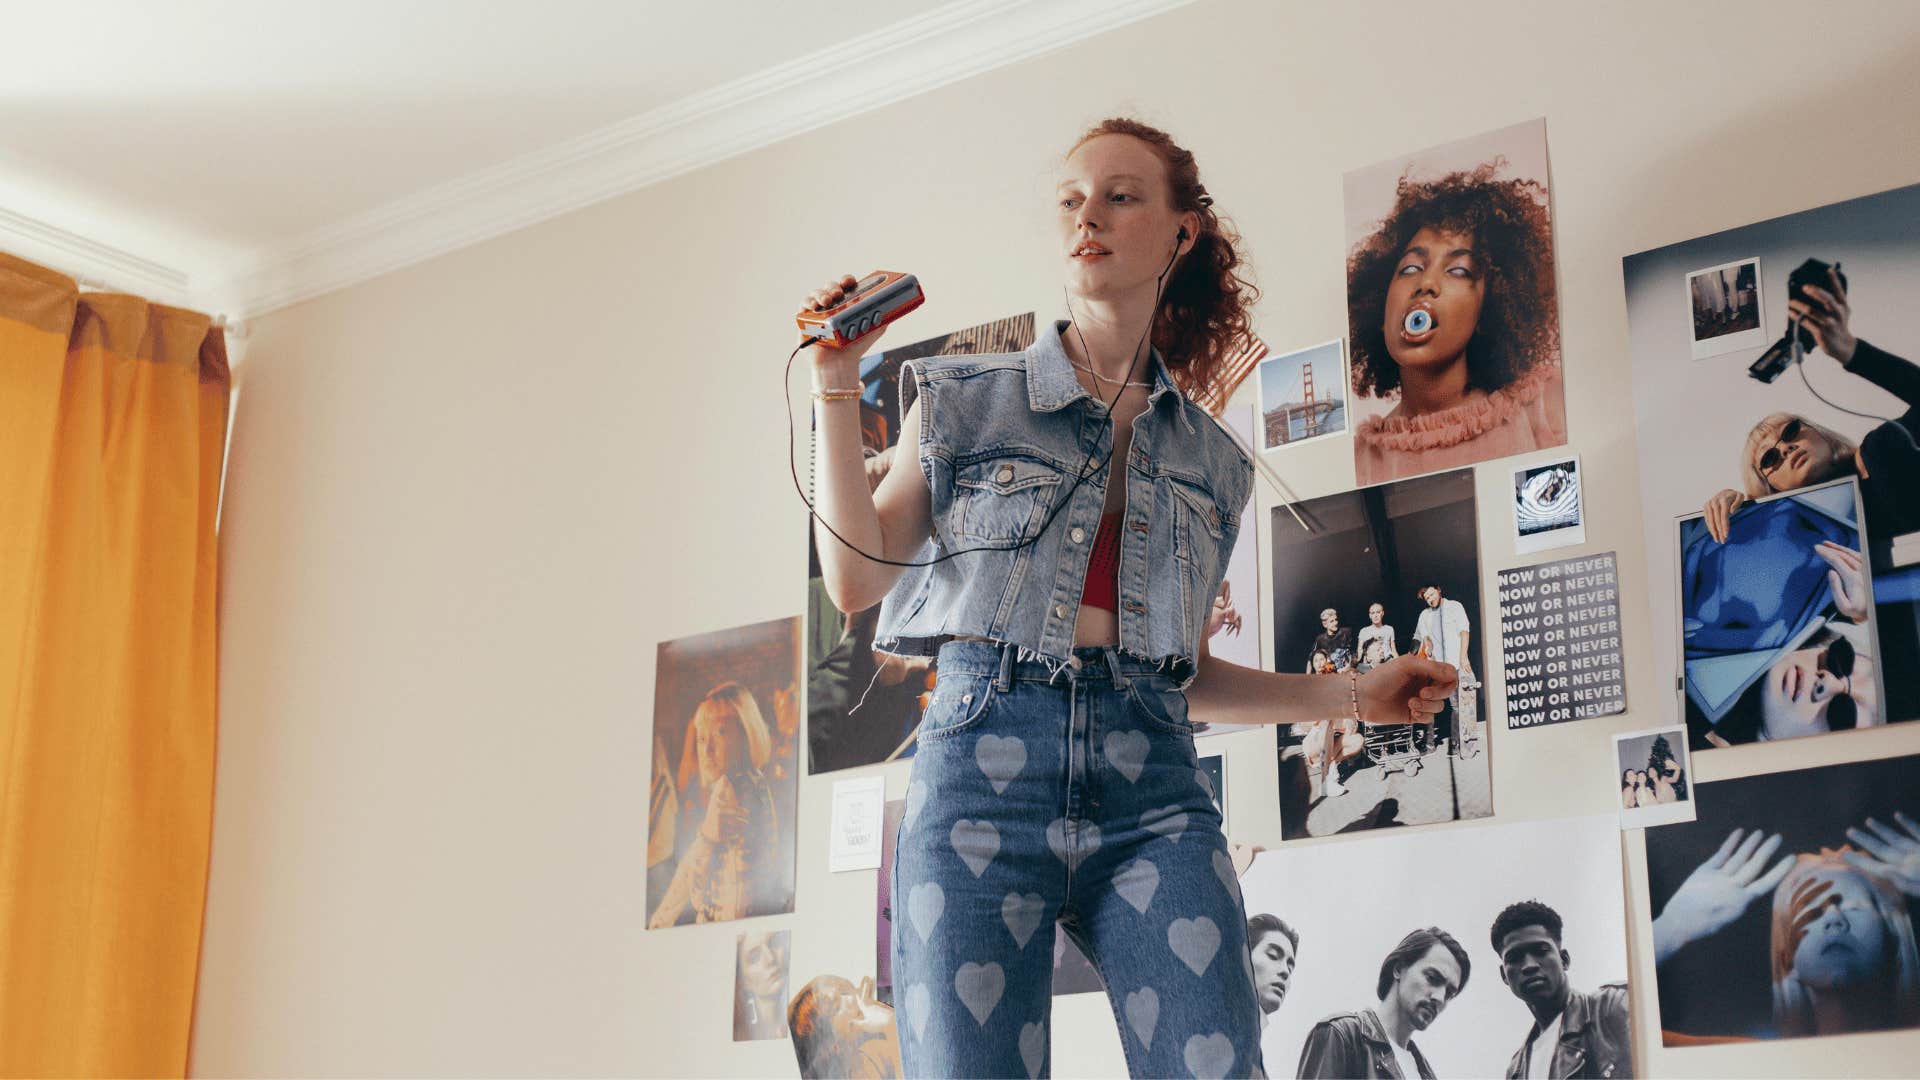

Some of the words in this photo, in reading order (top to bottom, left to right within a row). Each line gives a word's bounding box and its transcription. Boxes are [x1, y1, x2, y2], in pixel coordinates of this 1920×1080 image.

[1499, 570, 1534, 586] NOW
[1539, 566, 1560, 579] OR
[1564, 557, 1613, 575] NEVER
[1500, 586, 1535, 602] NOW
[1540, 582, 1561, 595] OR
[1566, 573, 1614, 590] NEVER
[1501, 602, 1536, 617] NOW
[1542, 598, 1562, 610] OR
[1567, 589, 1615, 606] NEVER
[1502, 617, 1538, 633] NOW
[1543, 614, 1563, 626] OR
[1568, 605, 1616, 622] NEVER
[1503, 633, 1539, 648] NOW
[1544, 630, 1565, 642] OR
[1570, 621, 1617, 638] NEVER
[1504, 649, 1541, 664] NOW
[1546, 646, 1566, 657] OR
[1571, 637, 1619, 654] NEVER
[1506, 665, 1541, 680] NOW
[1547, 661, 1567, 673] OR
[1572, 653, 1619, 670] NEVER
[1507, 680, 1543, 695] NOW
[1548, 677, 1568, 689] OR
[1573, 669, 1620, 685] NEVER
[1508, 696, 1544, 712] NOW
[1549, 693, 1569, 705] OR
[1574, 685, 1621, 701] NEVER
[1510, 712, 1545, 727] NOW
[1550, 709, 1571, 720] OR
[1575, 701, 1623, 717] NEVER
